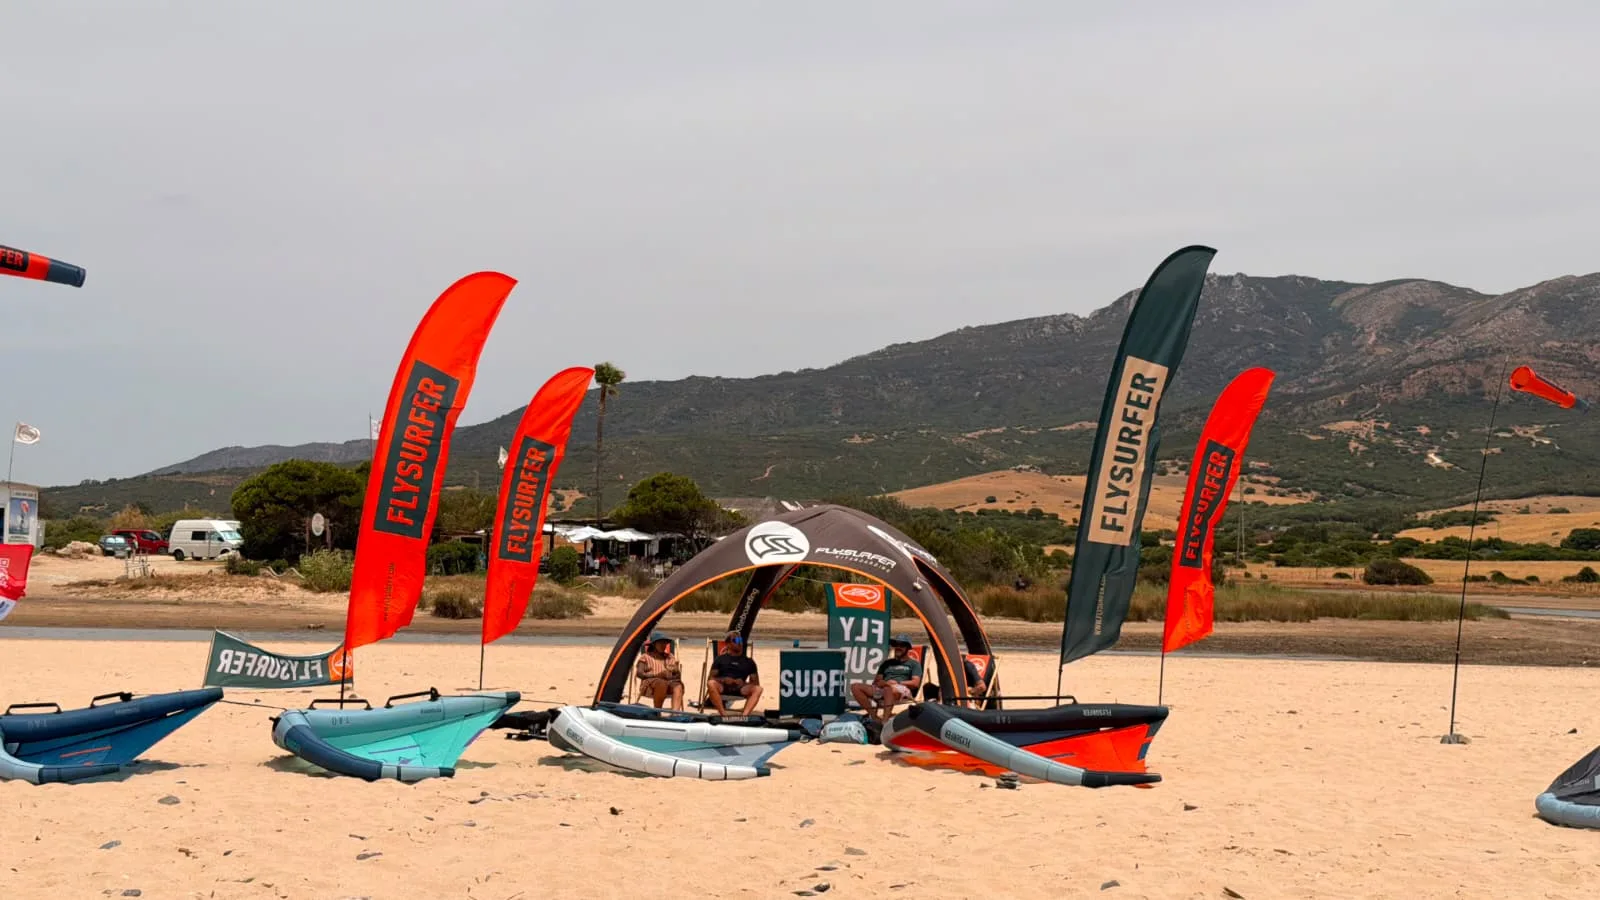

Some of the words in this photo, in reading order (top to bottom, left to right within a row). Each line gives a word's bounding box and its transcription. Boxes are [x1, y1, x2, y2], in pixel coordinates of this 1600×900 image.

[386, 377, 446, 526] FLYSURFER
[507, 447, 546, 553] FLYSURFER
[1101, 372, 1157, 532] FLYSURFER
[1186, 451, 1228, 559] FLYSURFER
